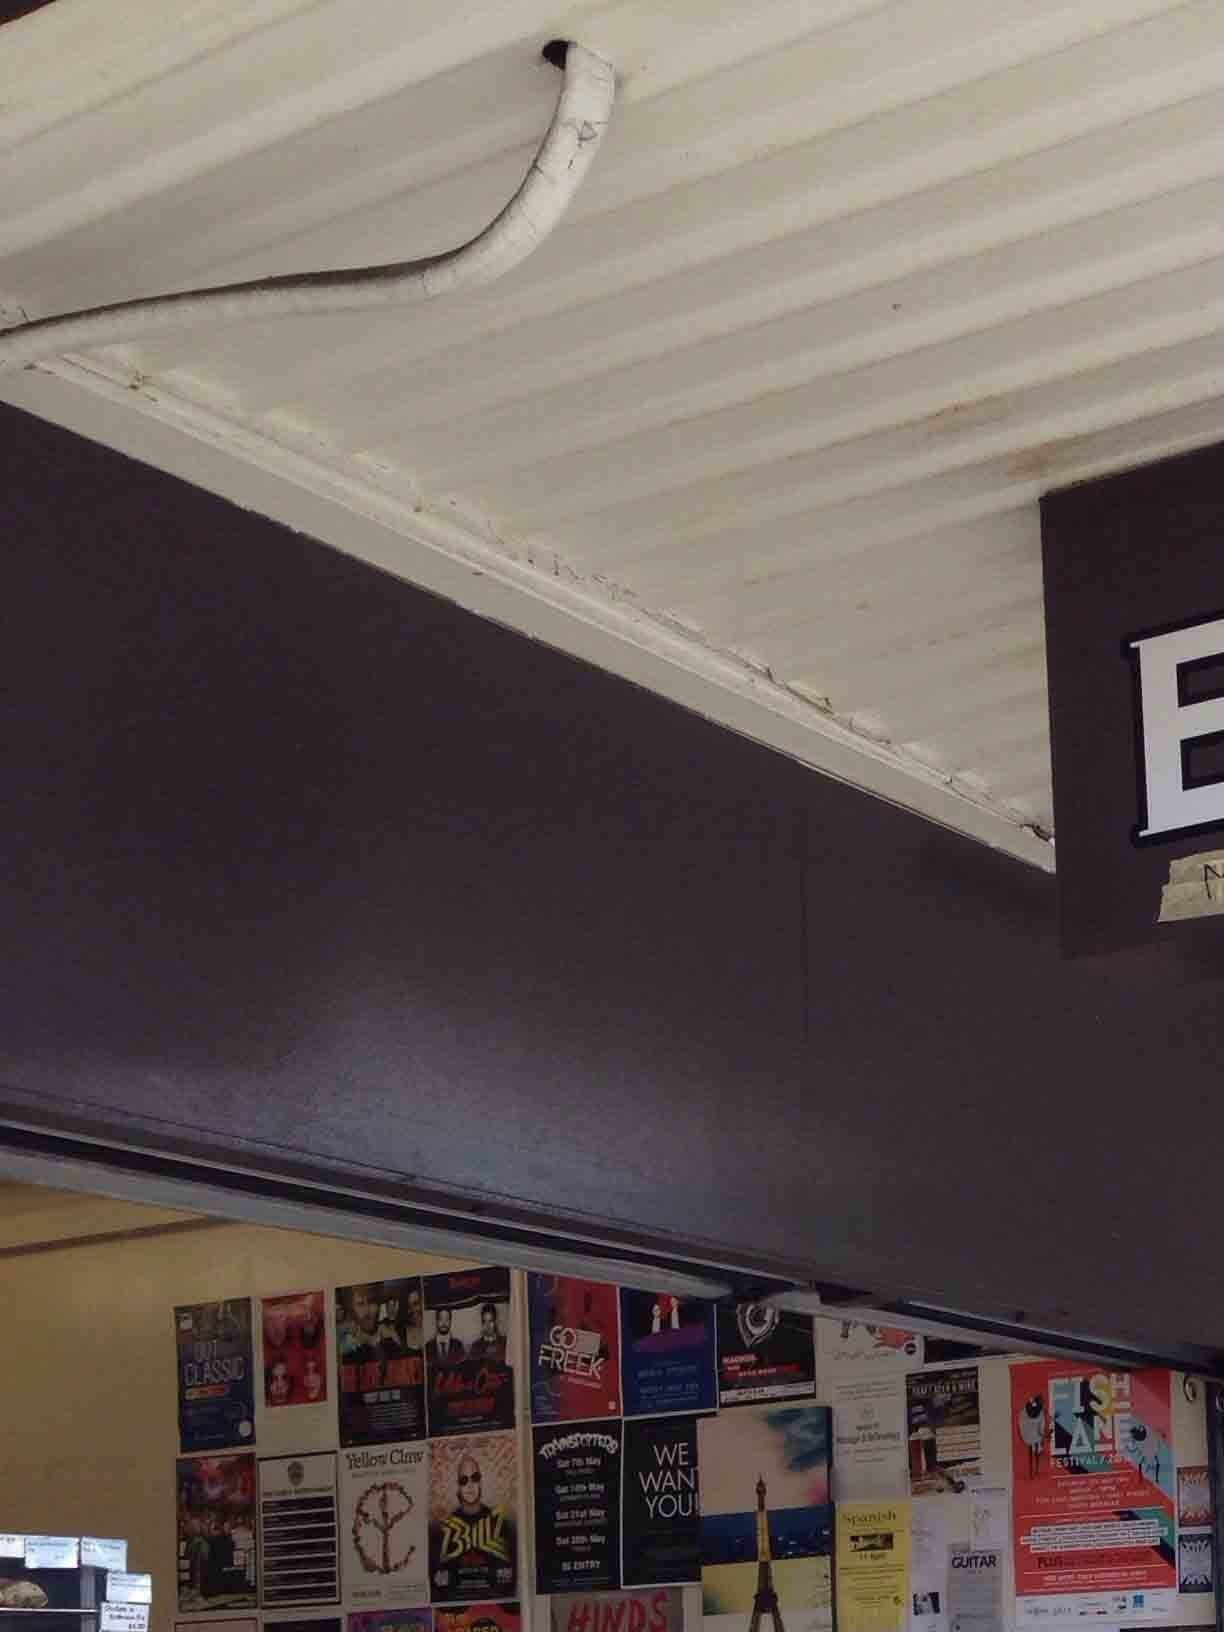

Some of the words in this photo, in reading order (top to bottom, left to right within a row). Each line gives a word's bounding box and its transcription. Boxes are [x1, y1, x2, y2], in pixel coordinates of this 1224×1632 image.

[346, 1451, 387, 1470] Yellow
[389, 1449, 424, 1465] Claw
[653, 1442, 689, 1468] WE
[639, 1466, 697, 1493] WAN
[951, 1555, 997, 1569] GUITAR
